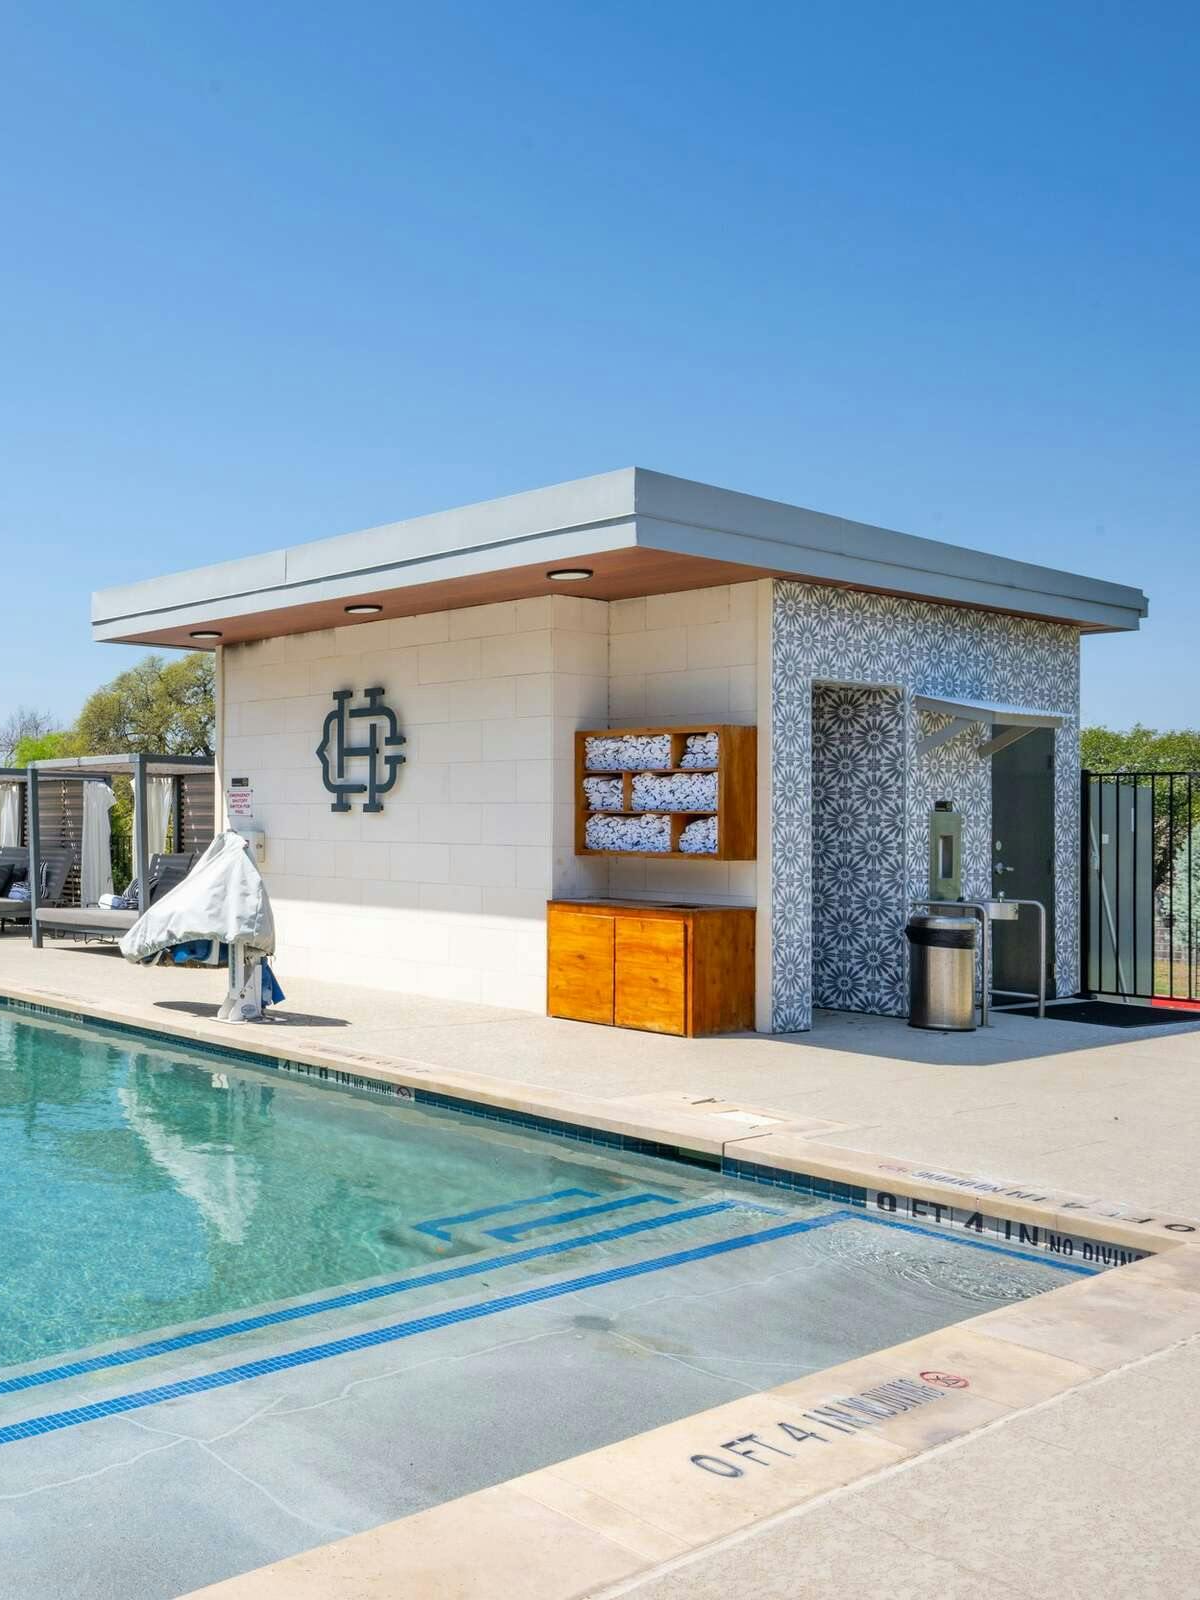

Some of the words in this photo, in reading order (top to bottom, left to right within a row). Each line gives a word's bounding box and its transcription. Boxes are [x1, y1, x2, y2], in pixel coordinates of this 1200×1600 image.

[912, 1198, 948, 1223] FT
[964, 1212, 983, 1233] 4
[1005, 1220, 1039, 1247] IN
[1050, 1234, 1073, 1256] NO
[777, 1422, 829, 1442] 4
[802, 1406, 874, 1434] IN
[720, 1433, 795, 1466] FT
